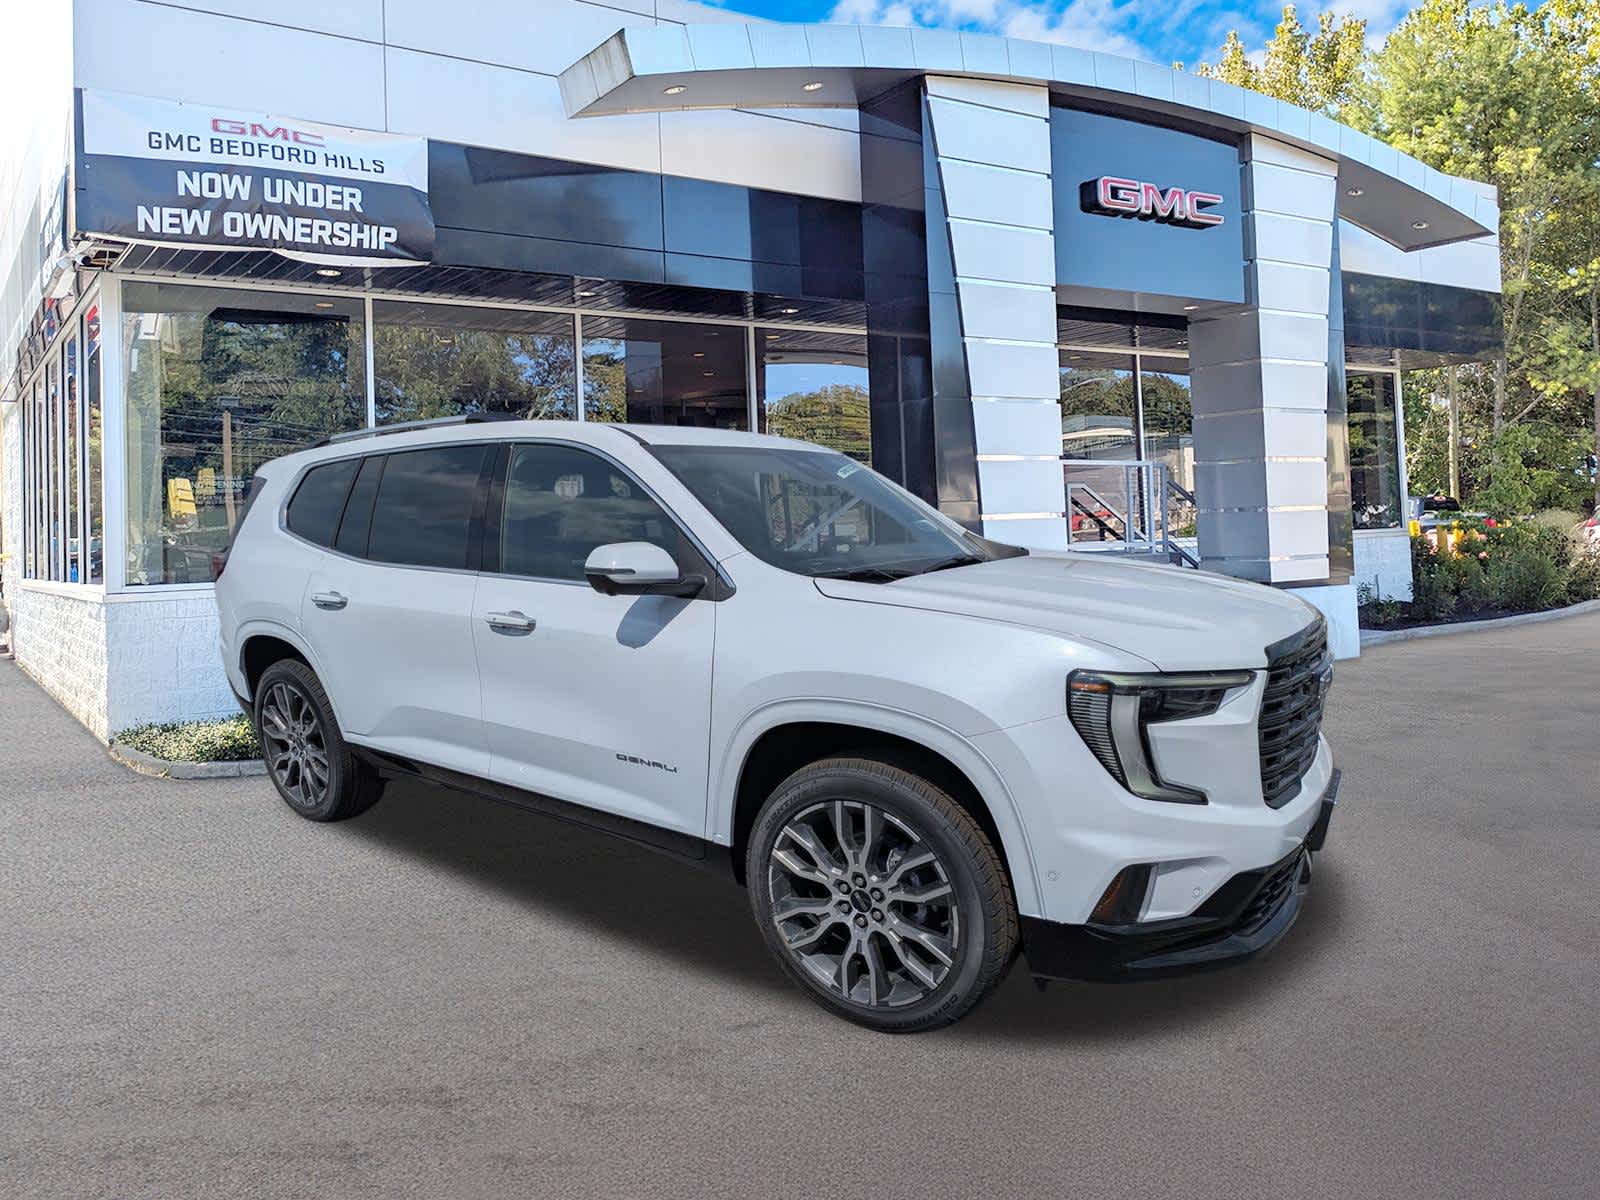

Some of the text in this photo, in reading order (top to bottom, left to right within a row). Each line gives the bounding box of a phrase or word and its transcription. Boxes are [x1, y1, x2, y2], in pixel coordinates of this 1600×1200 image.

[148, 131, 385, 174] GMC BEDFORD HILLS
[211, 118, 326, 148] GMC
[176, 170, 363, 213] NOW UNDER
[1097, 176, 1224, 226] GMC
[137, 205, 398, 250] NEW OWNERSHIP
[616, 753, 677, 773] DENALI
